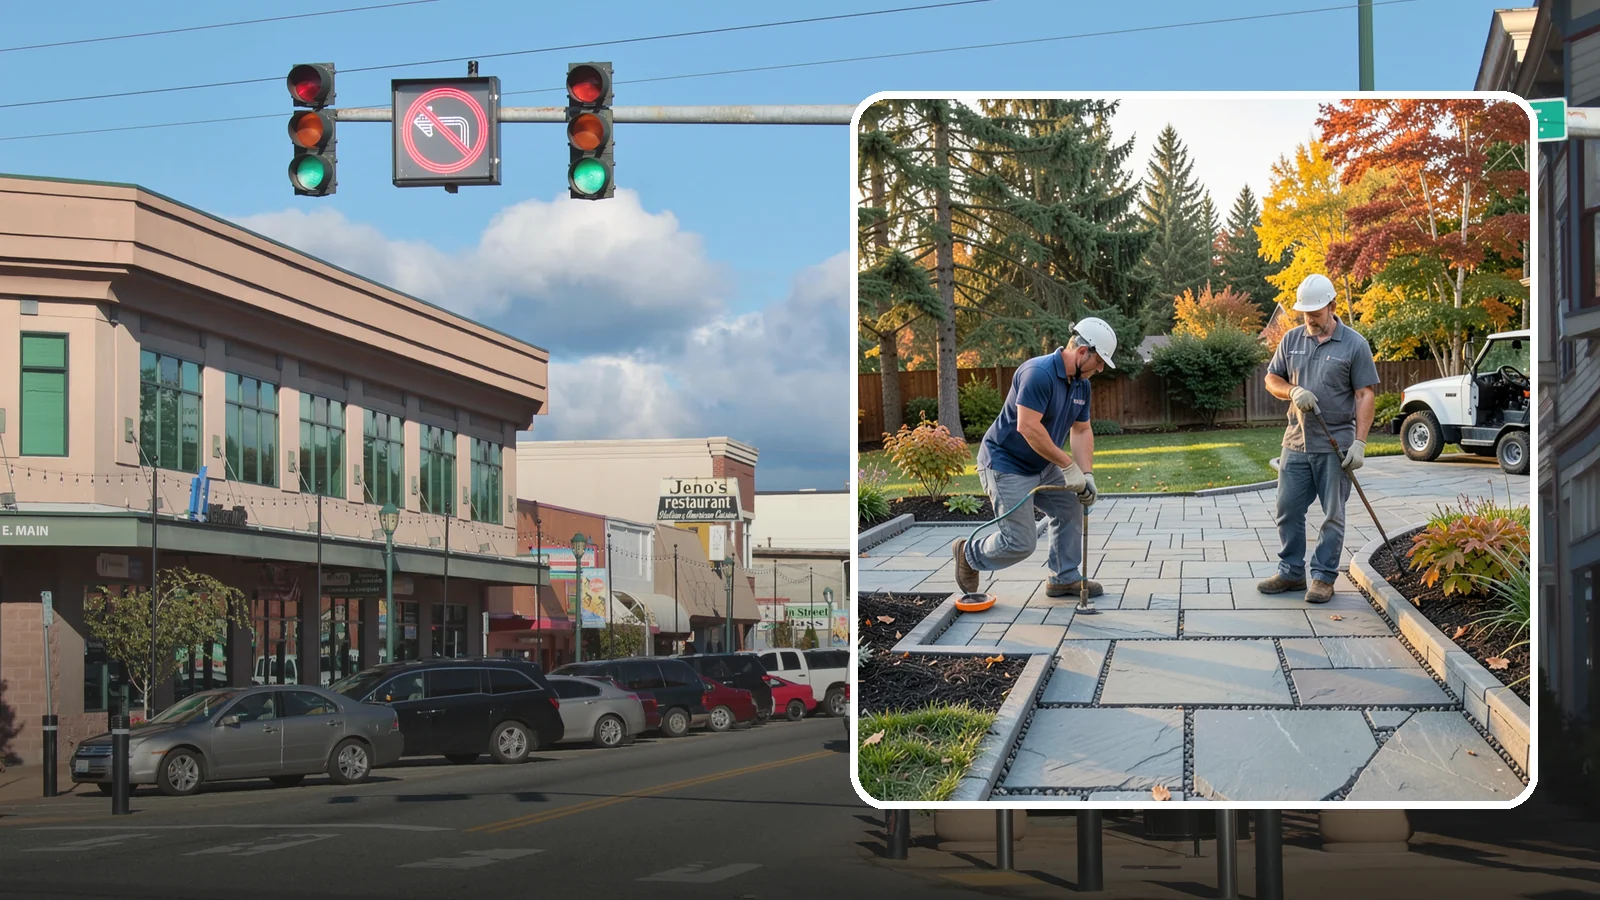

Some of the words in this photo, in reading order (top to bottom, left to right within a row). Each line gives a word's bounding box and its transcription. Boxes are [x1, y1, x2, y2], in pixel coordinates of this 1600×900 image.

[670, 480, 727, 494] Jeno's
[665, 497, 731, 509] restaurant
[658, 510, 681, 520] Italian
[686, 510, 714, 519] American
[715, 510, 737, 519] Cuisine
[2, 525, 13, 536] E.
[15, 525, 49, 536] MAIN
[797, 608, 828, 616] Street
[791, 619, 824, 627] lass
